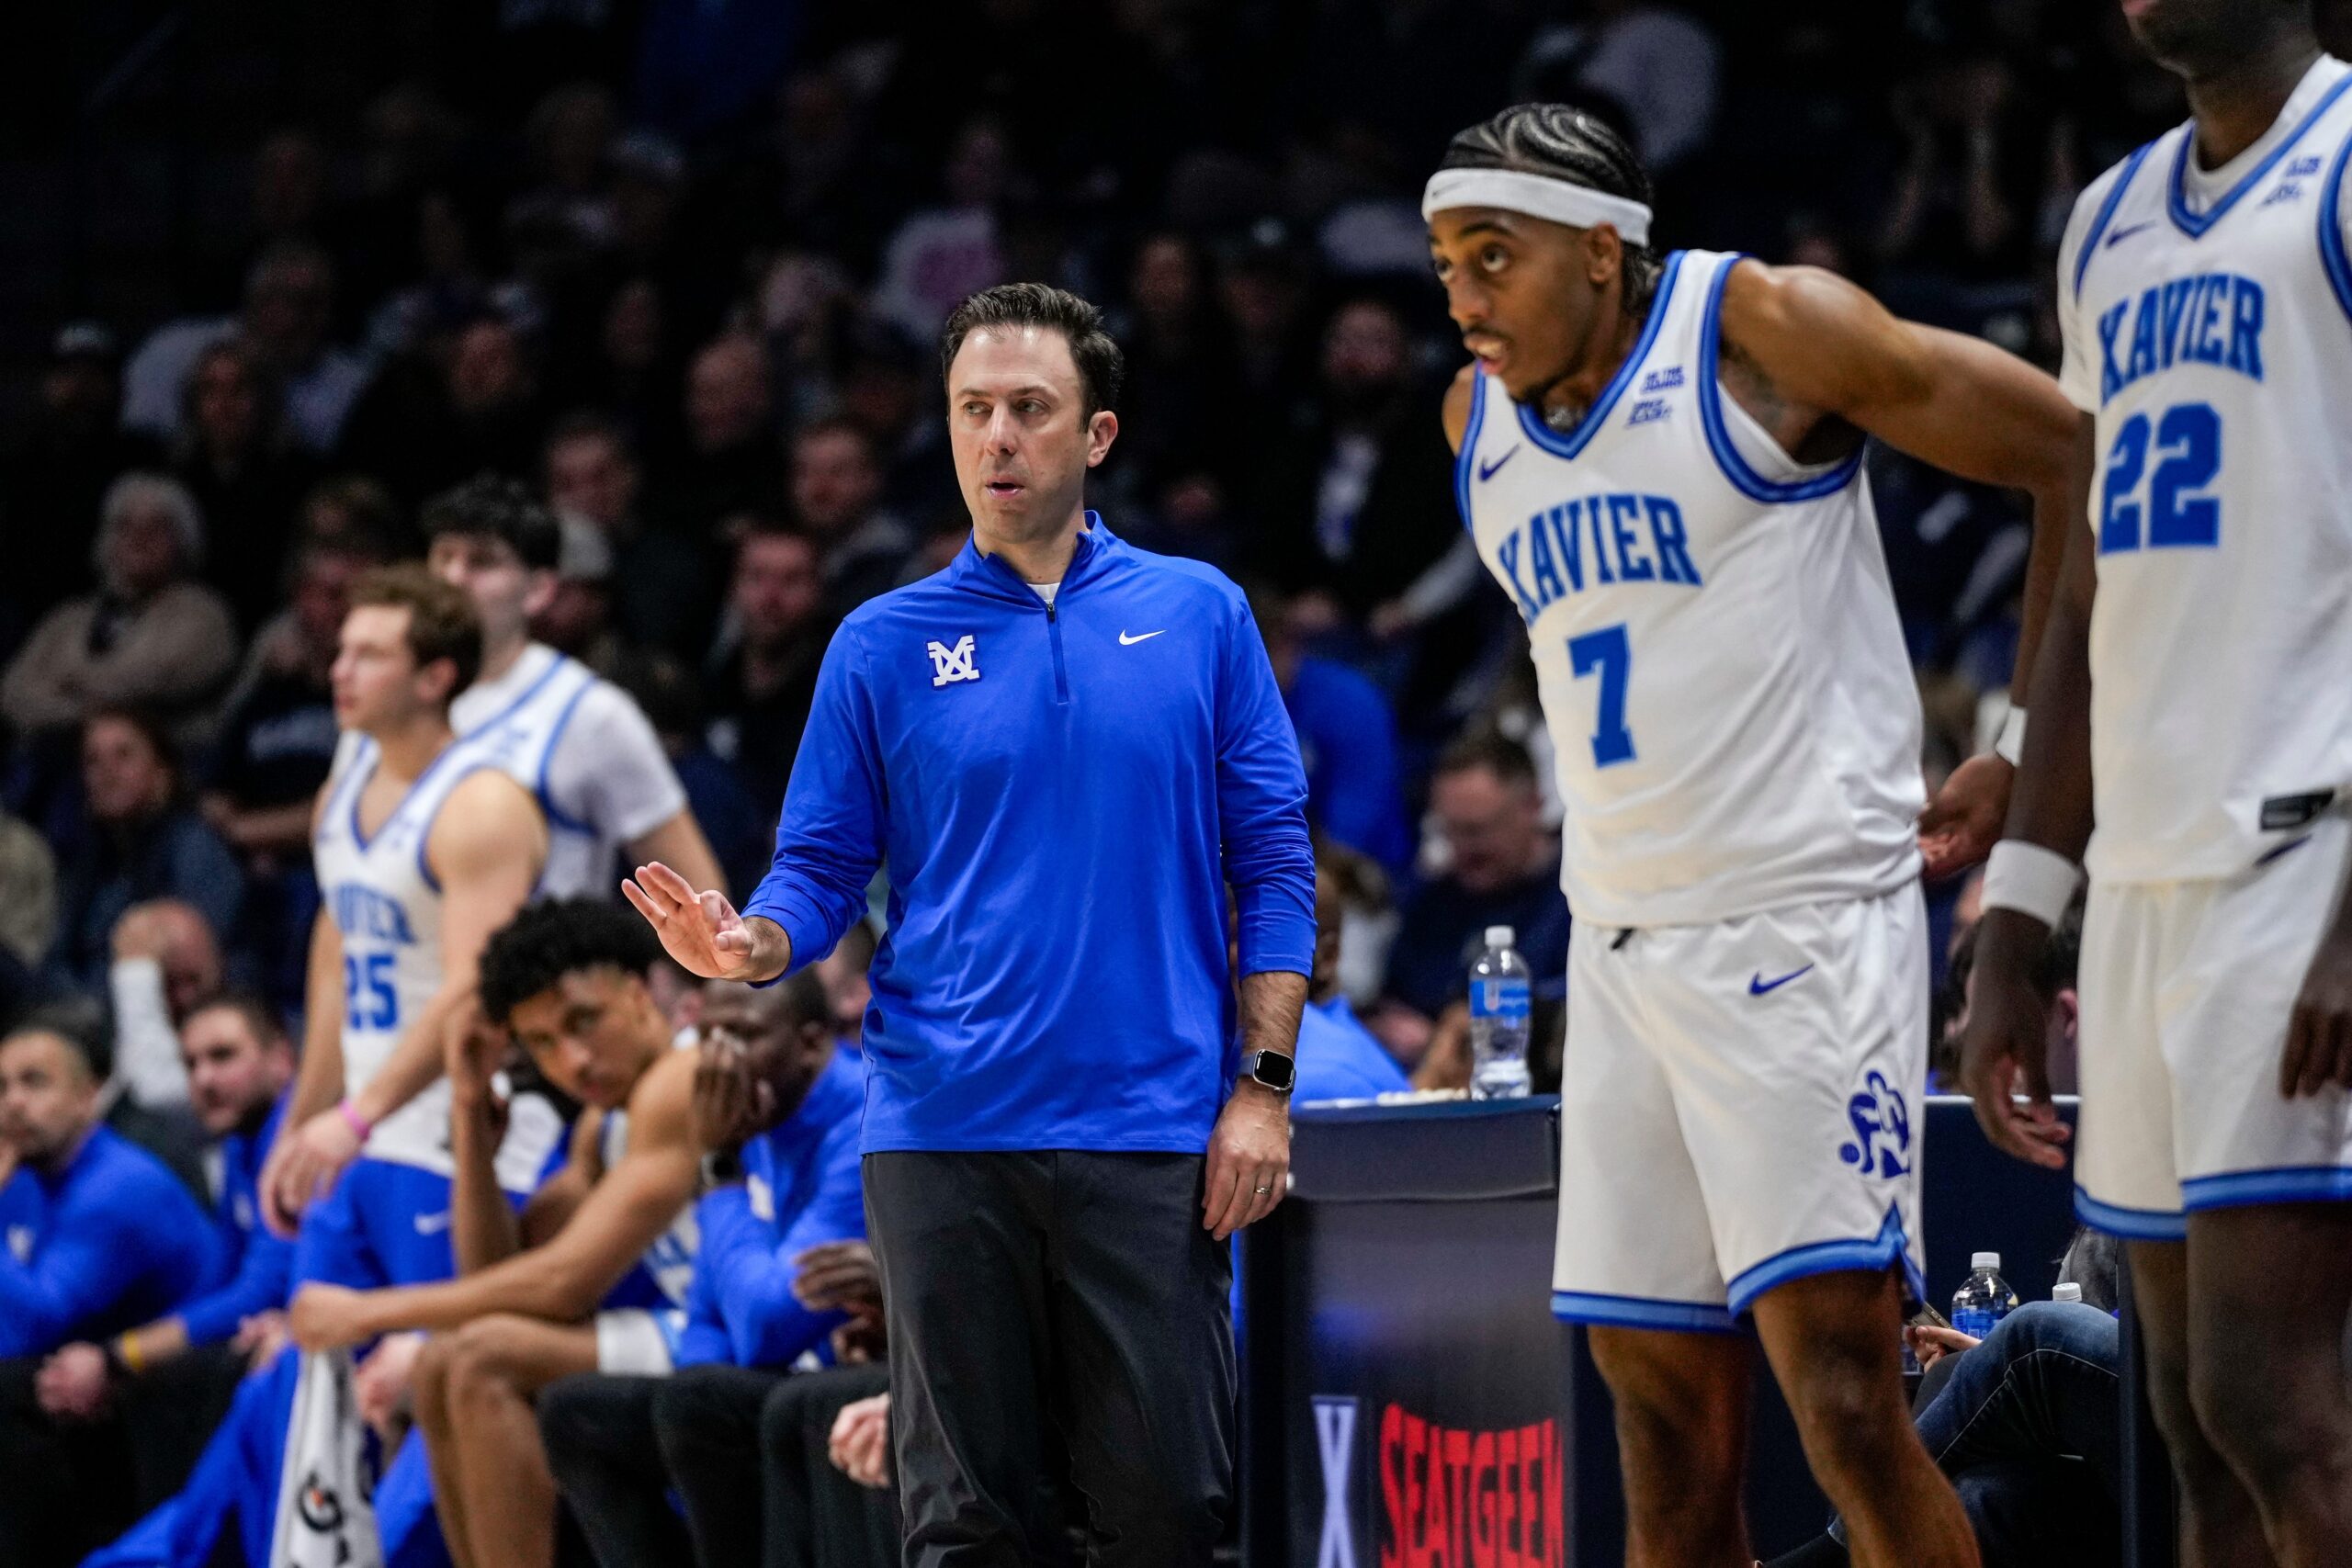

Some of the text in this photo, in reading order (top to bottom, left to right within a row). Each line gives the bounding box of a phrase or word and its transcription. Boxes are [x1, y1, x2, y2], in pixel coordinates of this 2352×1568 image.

[2098, 273, 2265, 406] XAVIER
[2098, 402, 2221, 556] 22
[1498, 493, 1703, 626] XAVIER
[1566, 623, 1636, 769] 7
